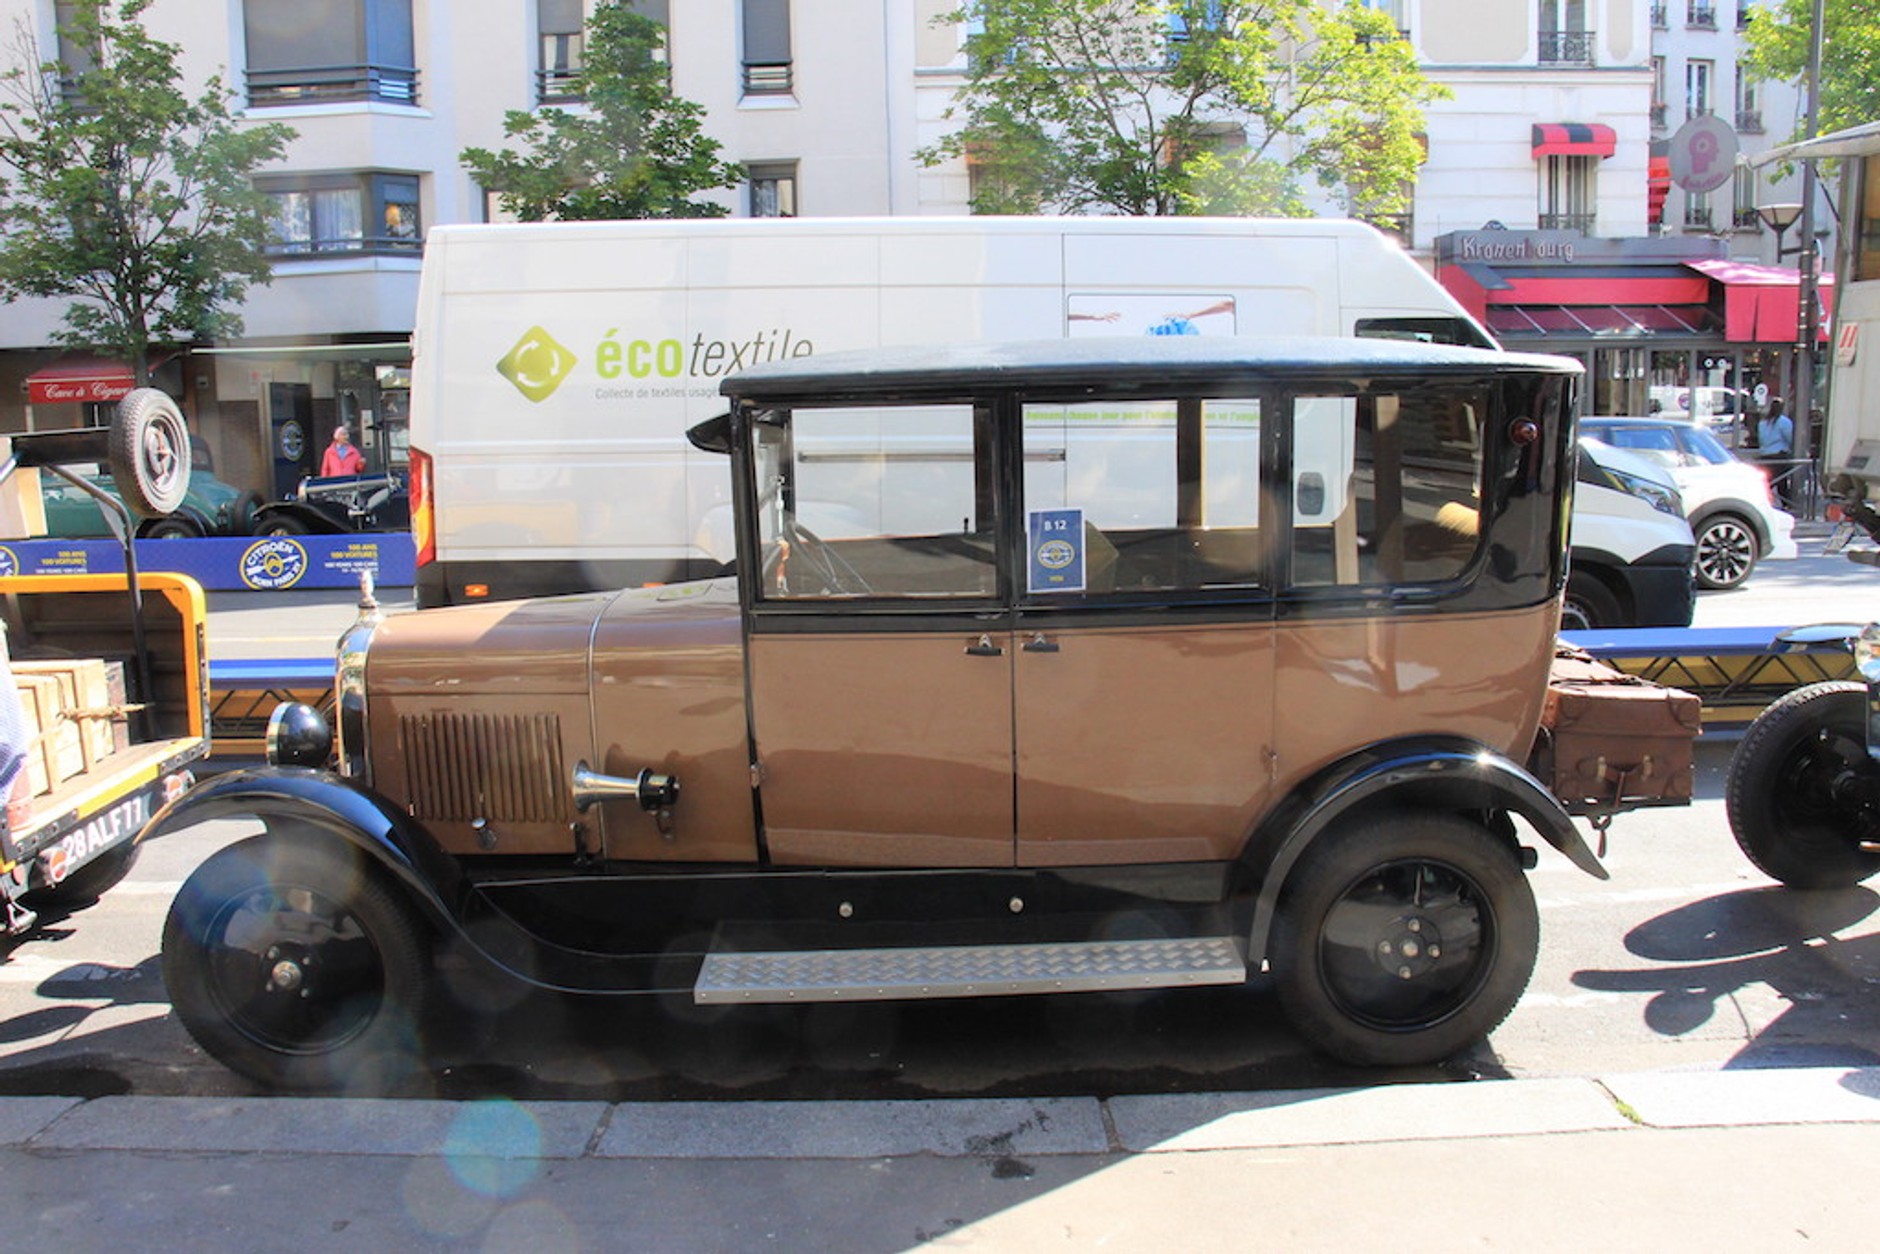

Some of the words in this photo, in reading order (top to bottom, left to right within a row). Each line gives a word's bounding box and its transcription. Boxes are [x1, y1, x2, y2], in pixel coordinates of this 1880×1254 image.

[595, 388, 634, 398] Collecte
[637, 388, 648, 398] de
[651, 386, 686, 398] textiles
[1044, 520, 1052, 532] B
[1054, 519, 1067, 531] 12
[62, 797, 142, 865] 28ALF77
